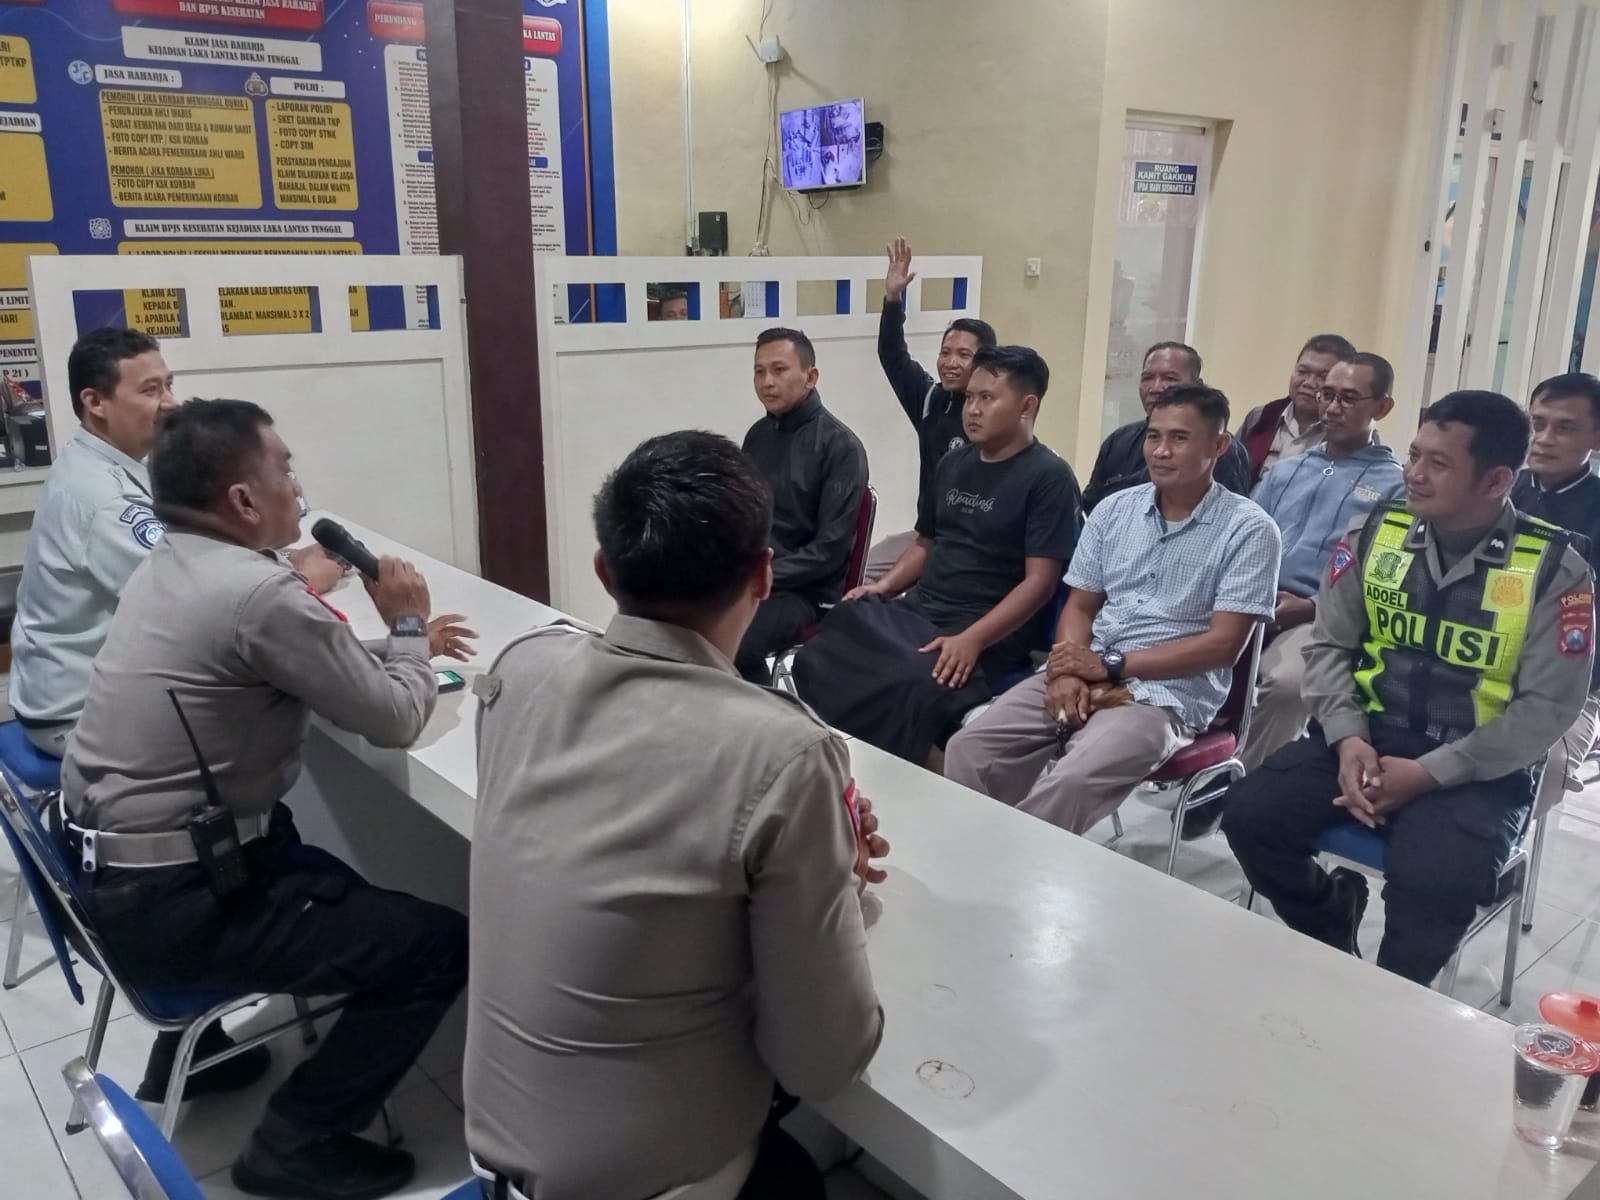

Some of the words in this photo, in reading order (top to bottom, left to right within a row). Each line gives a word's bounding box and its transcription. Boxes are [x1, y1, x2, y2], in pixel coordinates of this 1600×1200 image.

[179, 1, 198, 12] DAN
[199, 3, 220, 15] BPJS
[220, 5, 265, 19] KESEHATAN
[533, 30, 556, 41] LANTAS
[184, 36, 209, 47] KLAIM
[210, 39, 229, 48] JASA
[230, 40, 265, 51] RAHARJA
[147, 44, 187, 56] KEJADIAN
[188, 48, 209, 58] LAKA
[210, 50, 238, 60] LANTAS
[239, 52, 265, 62] BUKAN
[266, 54, 300, 65] TUNGGAL
[104, 69, 125, 79] JASA
[127, 71, 169, 82] RAHARJA
[294, 82, 319, 92] POLRI
[102, 91, 136, 102] PEMOHON
[276, 102, 309, 113] LAPORAN
[310, 103, 333, 114] POLISI
[110, 119, 131, 129] SURAT
[278, 115, 295, 124] SKET
[296, 116, 326, 126] GAMBAR
[327, 117, 341, 127] TKP
[112, 132, 130, 143] FOTO
[131, 133, 149, 144] COPY
[182, 135, 209, 145] KORBAN
[279, 128, 298, 138] FOTO
[298, 128, 317, 139] COPY
[319, 129, 337, 139] STNK
[280, 140, 299, 150] COPY
[300, 141, 314, 151] SIM
[113, 146, 138, 156] BERITA
[139, 146, 162, 157] ACARA
[276, 156, 317, 167] PERSYARATAN
[111, 165, 145, 175] PEMOHON
[166, 166, 193, 177] KORBAN
[1154, 164, 1180, 173] RUANG
[1137, 171, 1162, 180] KANIT
[1162, 172, 1194, 182] GAKKUM
[117, 178, 136, 189] FOTO
[136, 179, 154, 189] COPY
[169, 179, 196, 190] KORBAN
[308, 183, 329, 192] DALAM
[119, 191, 143, 202] BERITA
[144, 192, 167, 202] ACARA
[167, 192, 213, 203] PEMERIKSAAN
[213, 193, 239, 203] KORBAN
[134, 223, 160, 233] KLAIM
[161, 223, 181, 234] BPJS
[182, 223, 225, 233] KESEHATAN
[226, 223, 262, 234] KEJADIAN
[263, 224, 283, 233] LAKA
[283, 224, 310, 233] LANTAS
[310, 225, 343, 234] TUNGGAL
[141, 288, 166, 298] KLAIM
[6, 296, 29, 305] LIMIT
[143, 301, 172, 311] KEPADA
[145, 313, 176, 323] APABILA
[255, 310, 292, 320] MAKSIMAL
[292, 310, 298, 319] 3
[1366, 584, 1405, 609] ADOEL
